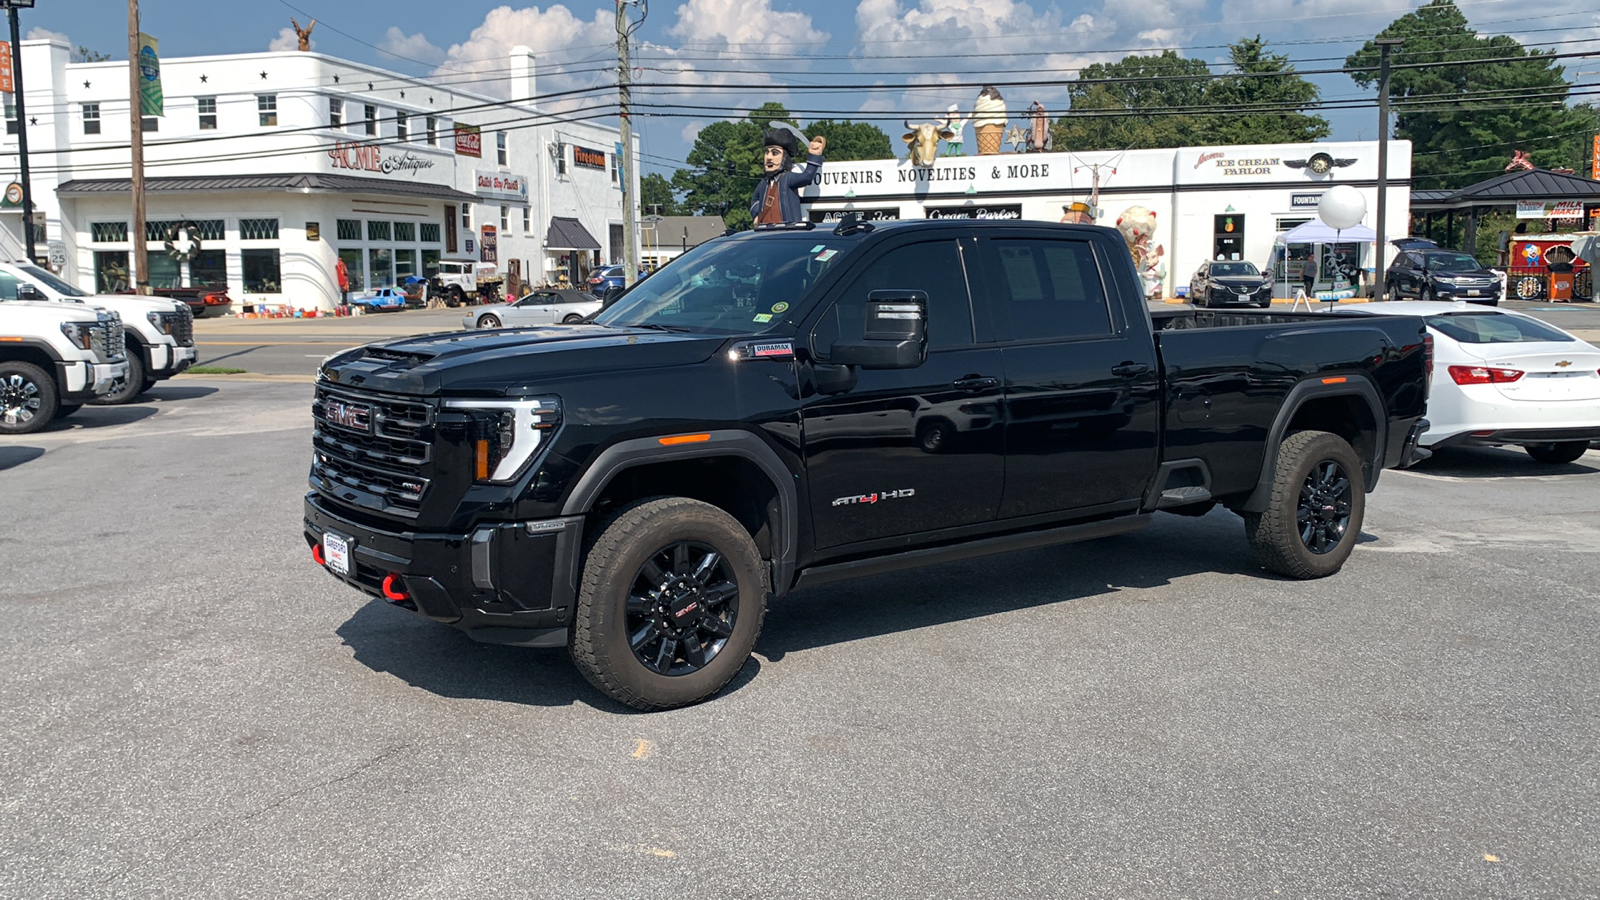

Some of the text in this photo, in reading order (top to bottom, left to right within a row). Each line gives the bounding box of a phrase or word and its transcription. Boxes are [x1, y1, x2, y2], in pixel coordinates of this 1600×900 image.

[328, 140, 434, 176] ACME Antiques
[1215, 158, 1280, 167] ICE CREAM
[813, 164, 1050, 185] OUVENIRS NOVELTIES & MORE
[478, 175, 519, 191] Dutch Boy Paints
[929, 209, 970, 220] Cream
[976, 208, 1020, 220] Parlor
[51, 255, 65, 264] 25
[484, 249, 496, 260] TEA
[326, 401, 369, 430] GMC
[832, 488, 916, 507] AT4 HD
[675, 601, 698, 618] GMC
